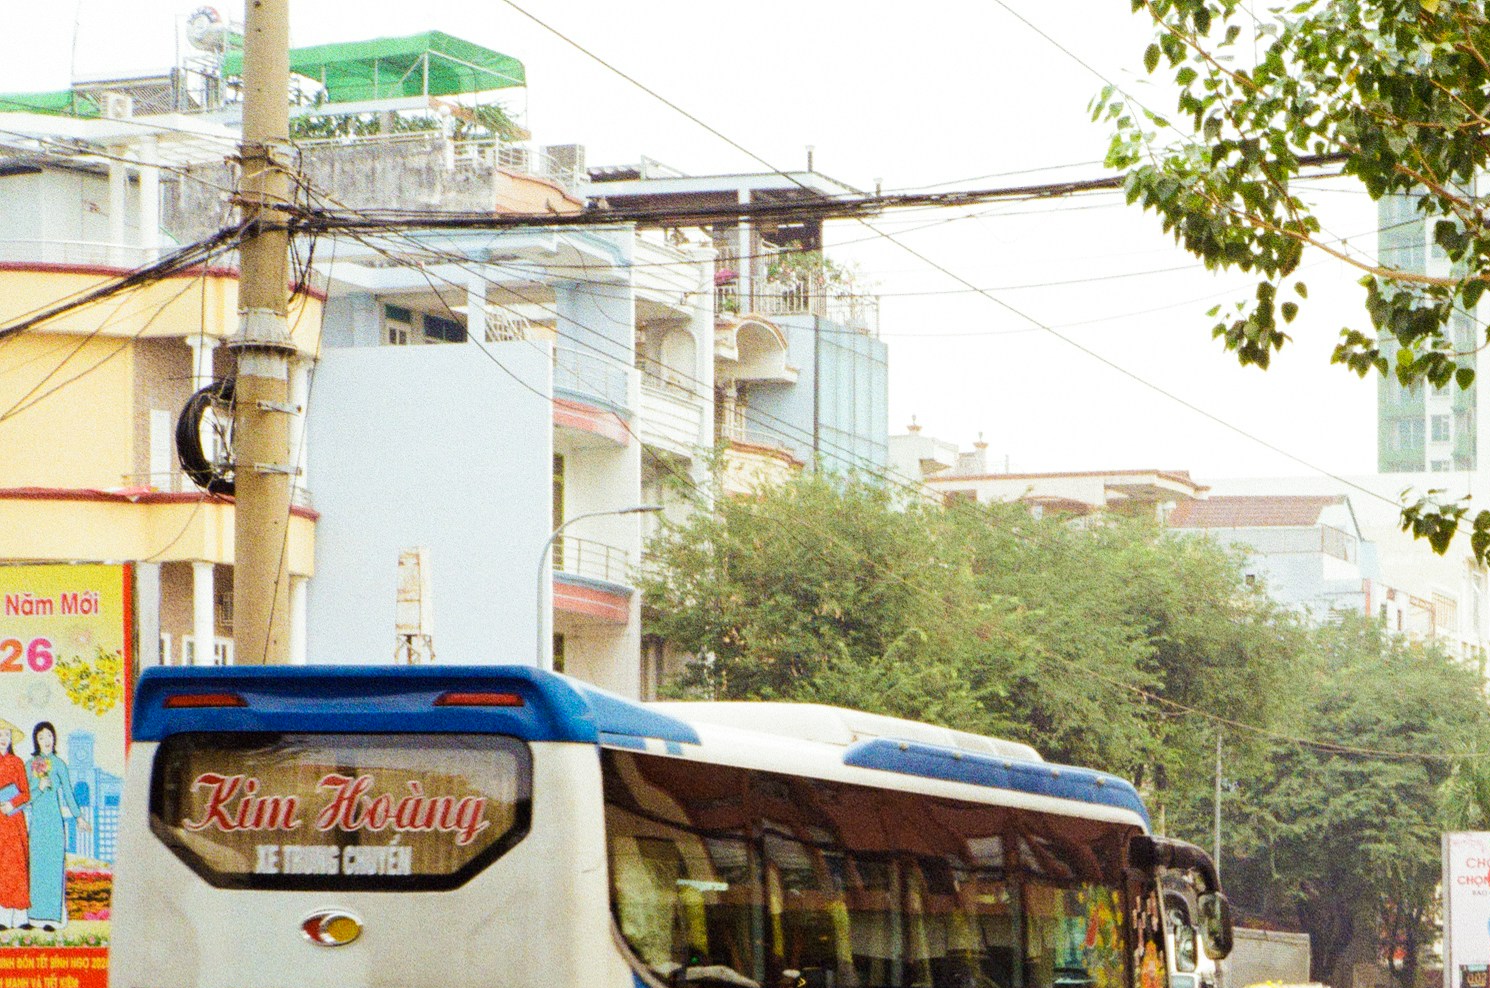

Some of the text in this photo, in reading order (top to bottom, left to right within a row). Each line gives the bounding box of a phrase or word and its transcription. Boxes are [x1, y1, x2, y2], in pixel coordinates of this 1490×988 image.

[5, 592, 54, 616] Năm
[183, 772, 489, 846] Kim Hoàng
